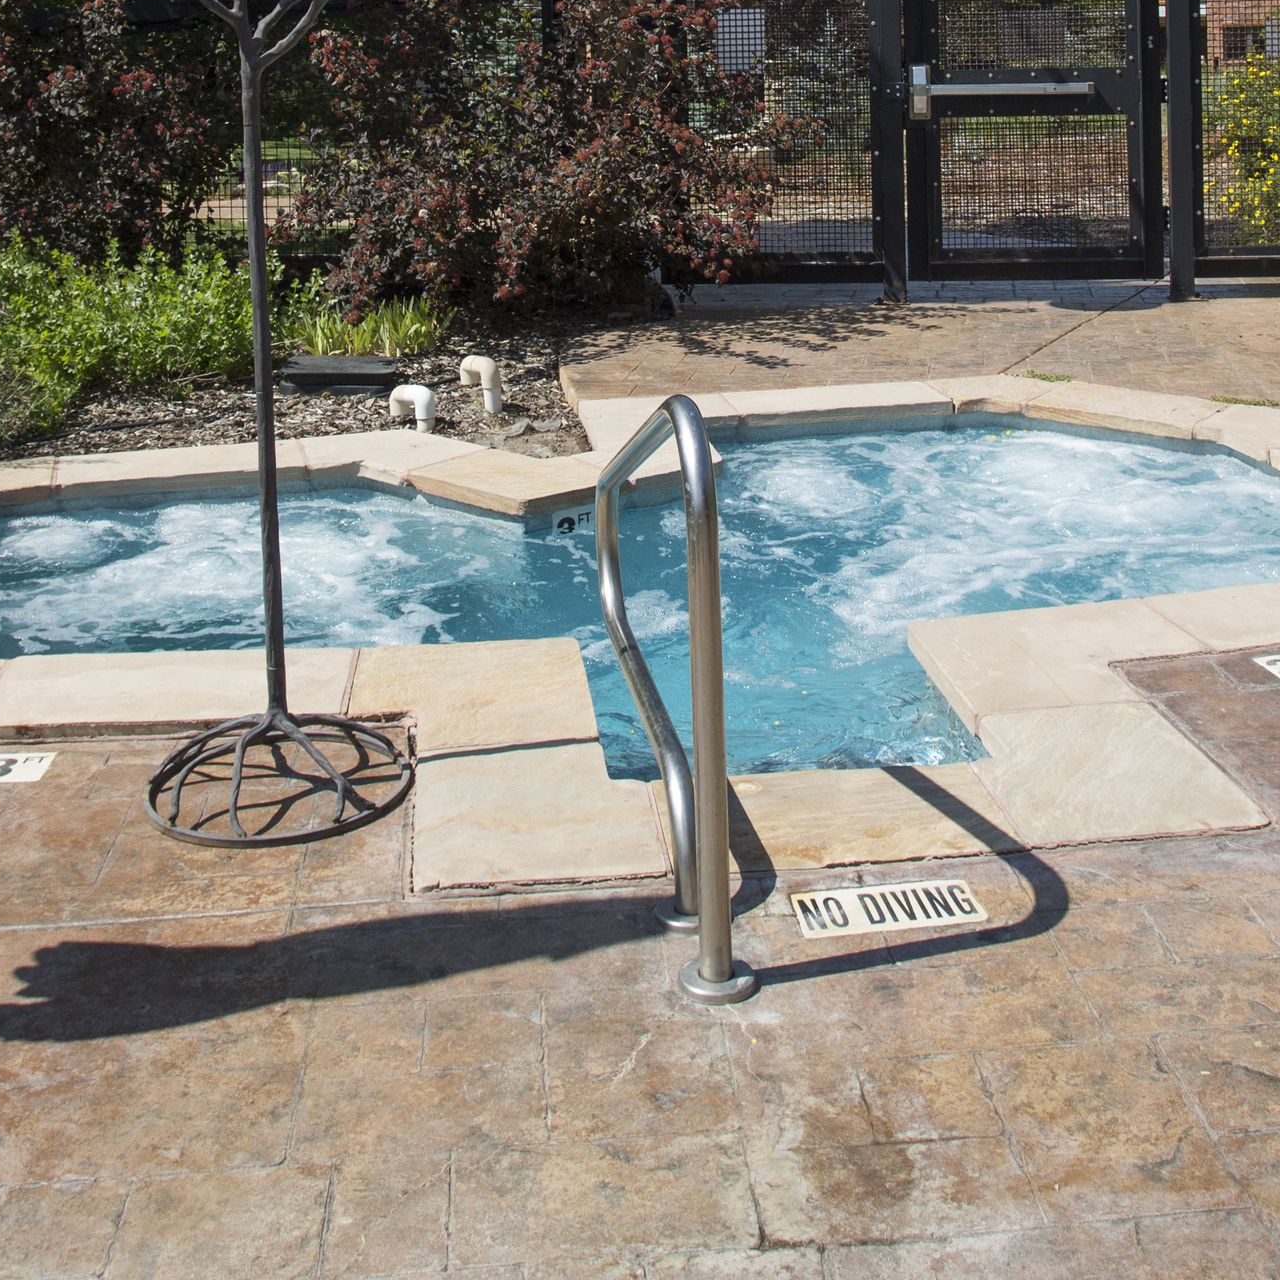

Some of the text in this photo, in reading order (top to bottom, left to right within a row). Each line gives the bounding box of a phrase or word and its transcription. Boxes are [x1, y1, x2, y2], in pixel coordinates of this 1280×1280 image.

[578, 511, 591, 524] FT
[23, 756, 49, 764] FT
[796, 884, 979, 931] NO DIVING
